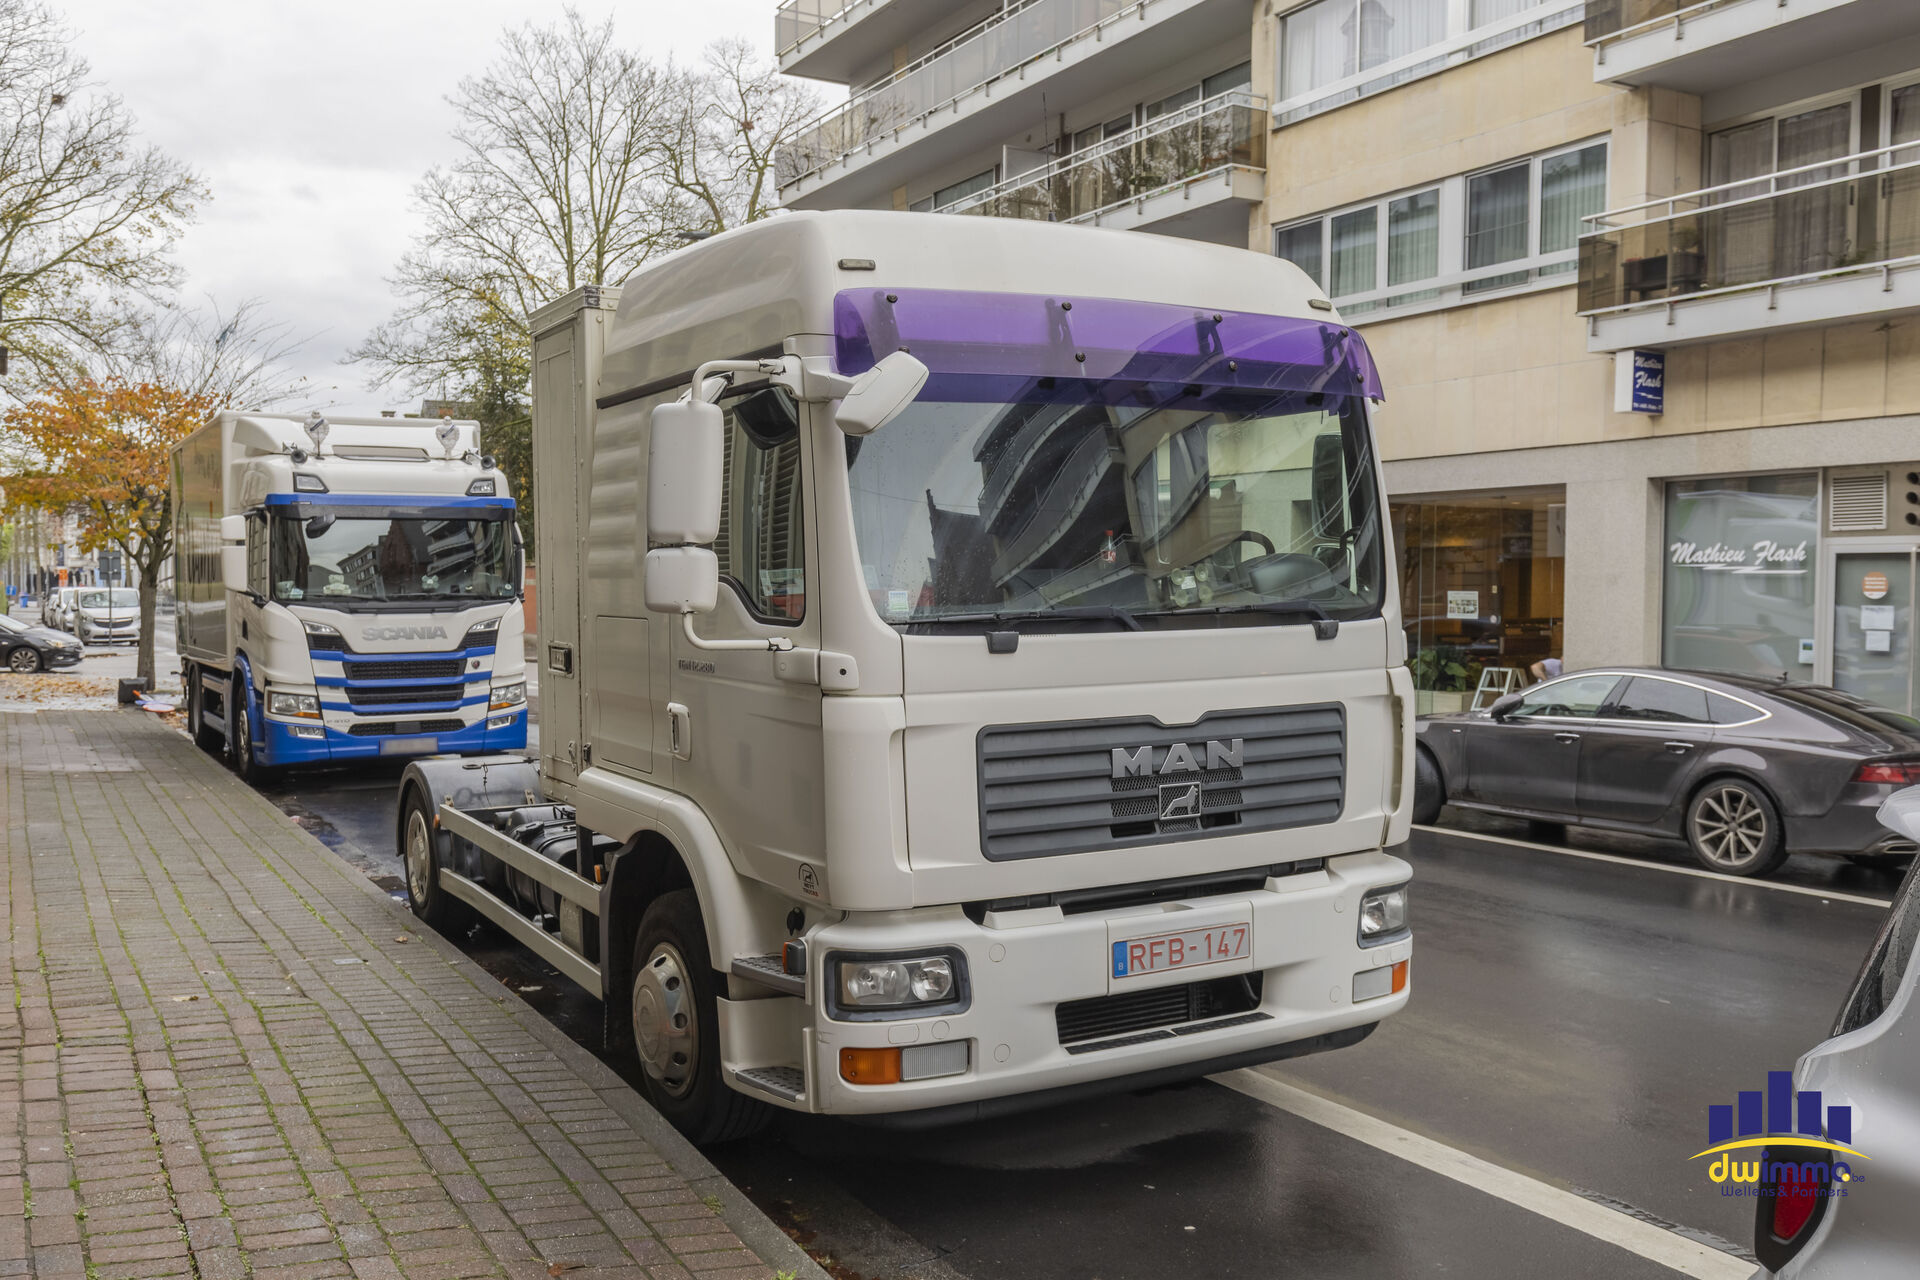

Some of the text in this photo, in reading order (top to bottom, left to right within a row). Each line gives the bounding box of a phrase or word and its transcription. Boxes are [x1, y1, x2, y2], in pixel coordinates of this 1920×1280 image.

[1635, 371, 1662, 388] Flash
[1670, 540, 1807, 565] Mathieu Flash
[362, 627, 448, 641] SCANIA
[1112, 738, 1243, 778] MAN
[1130, 928, 1246, 972] RFB-147
[1118, 962, 1124, 971] B
